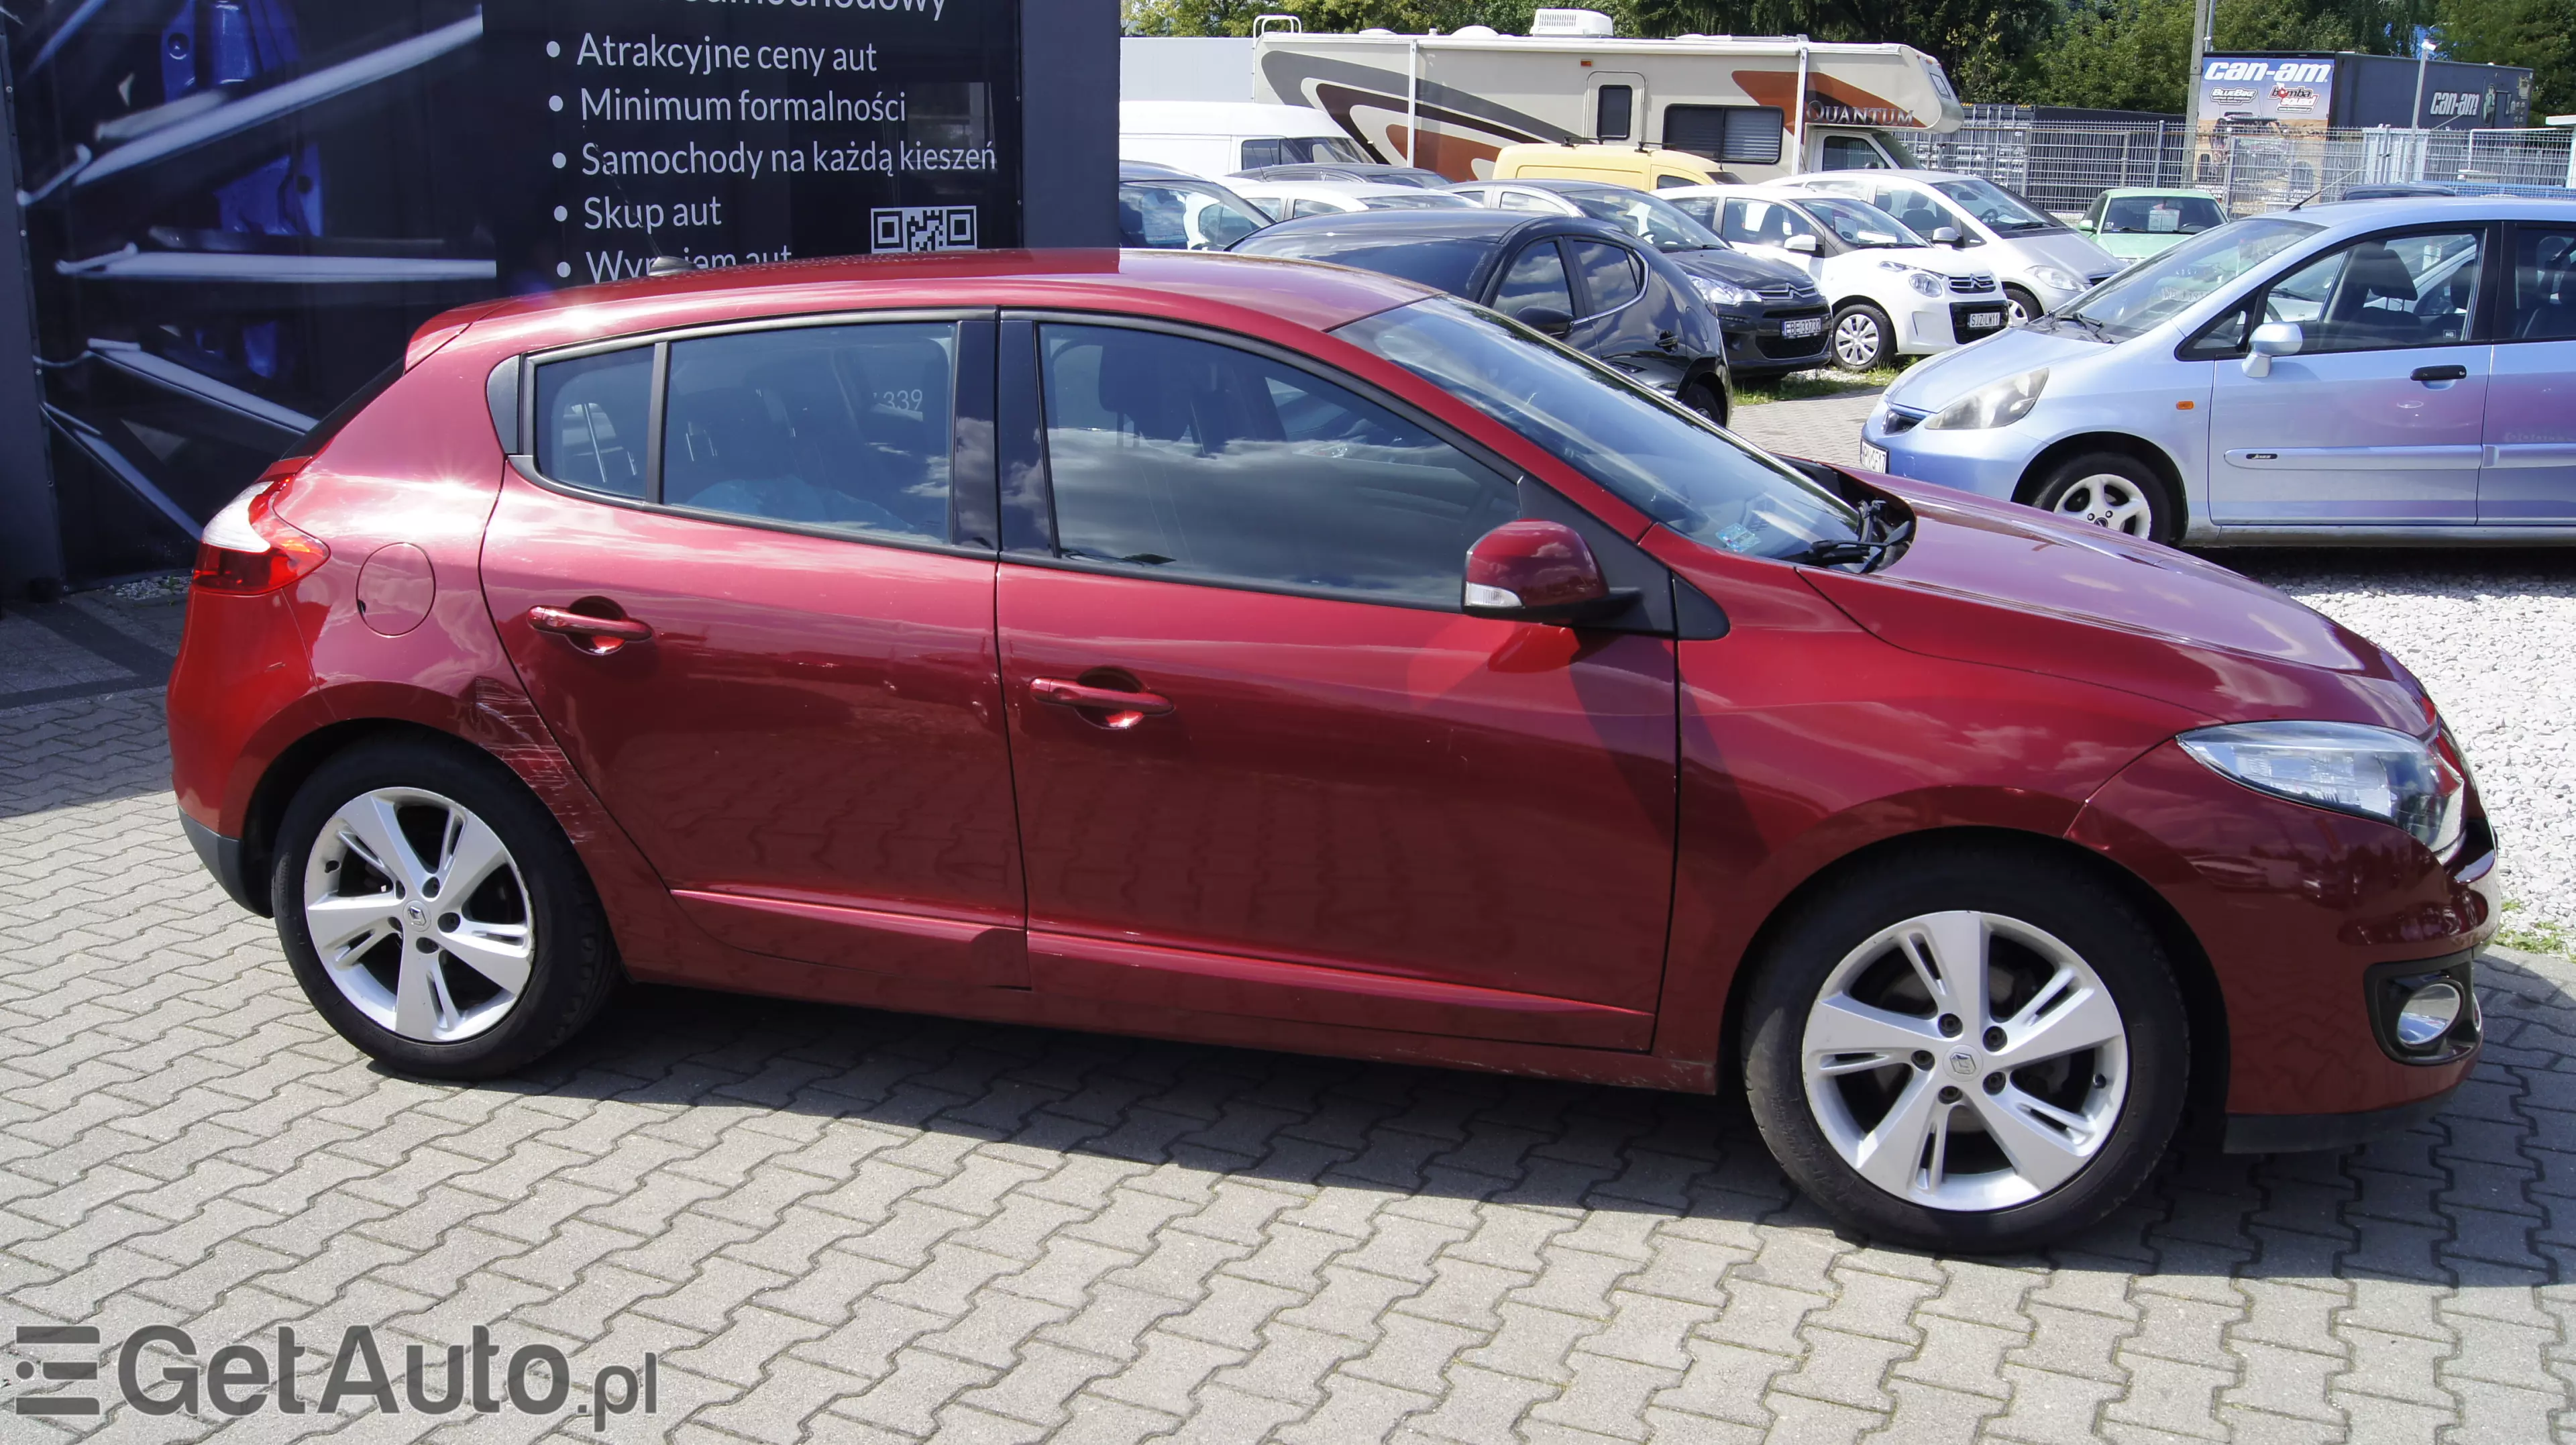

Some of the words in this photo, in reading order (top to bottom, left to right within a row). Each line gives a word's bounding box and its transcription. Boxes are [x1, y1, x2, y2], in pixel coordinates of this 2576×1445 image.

[577, 33, 750, 74] Atrakcyjne
[758, 47, 825, 76] ceny
[833, 44, 877, 70] aut
[2204, 62, 2330, 83] can-am
[582, 89, 731, 121] Minimum
[739, 90, 905, 121] formalności
[1806, 100, 1915, 126] QUANTUM
[2430, 92, 2480, 115] can-am
[583, 142, 763, 178] Samochody
[772, 150, 804, 172] na
[814, 141, 894, 177] każdą
[901, 141, 996, 170] kieszeń
[585, 197, 664, 235] Skup
[674, 197, 722, 227] aut
[1786, 321, 1800, 335] EBE
[1802, 319, 1820, 333] 33732
